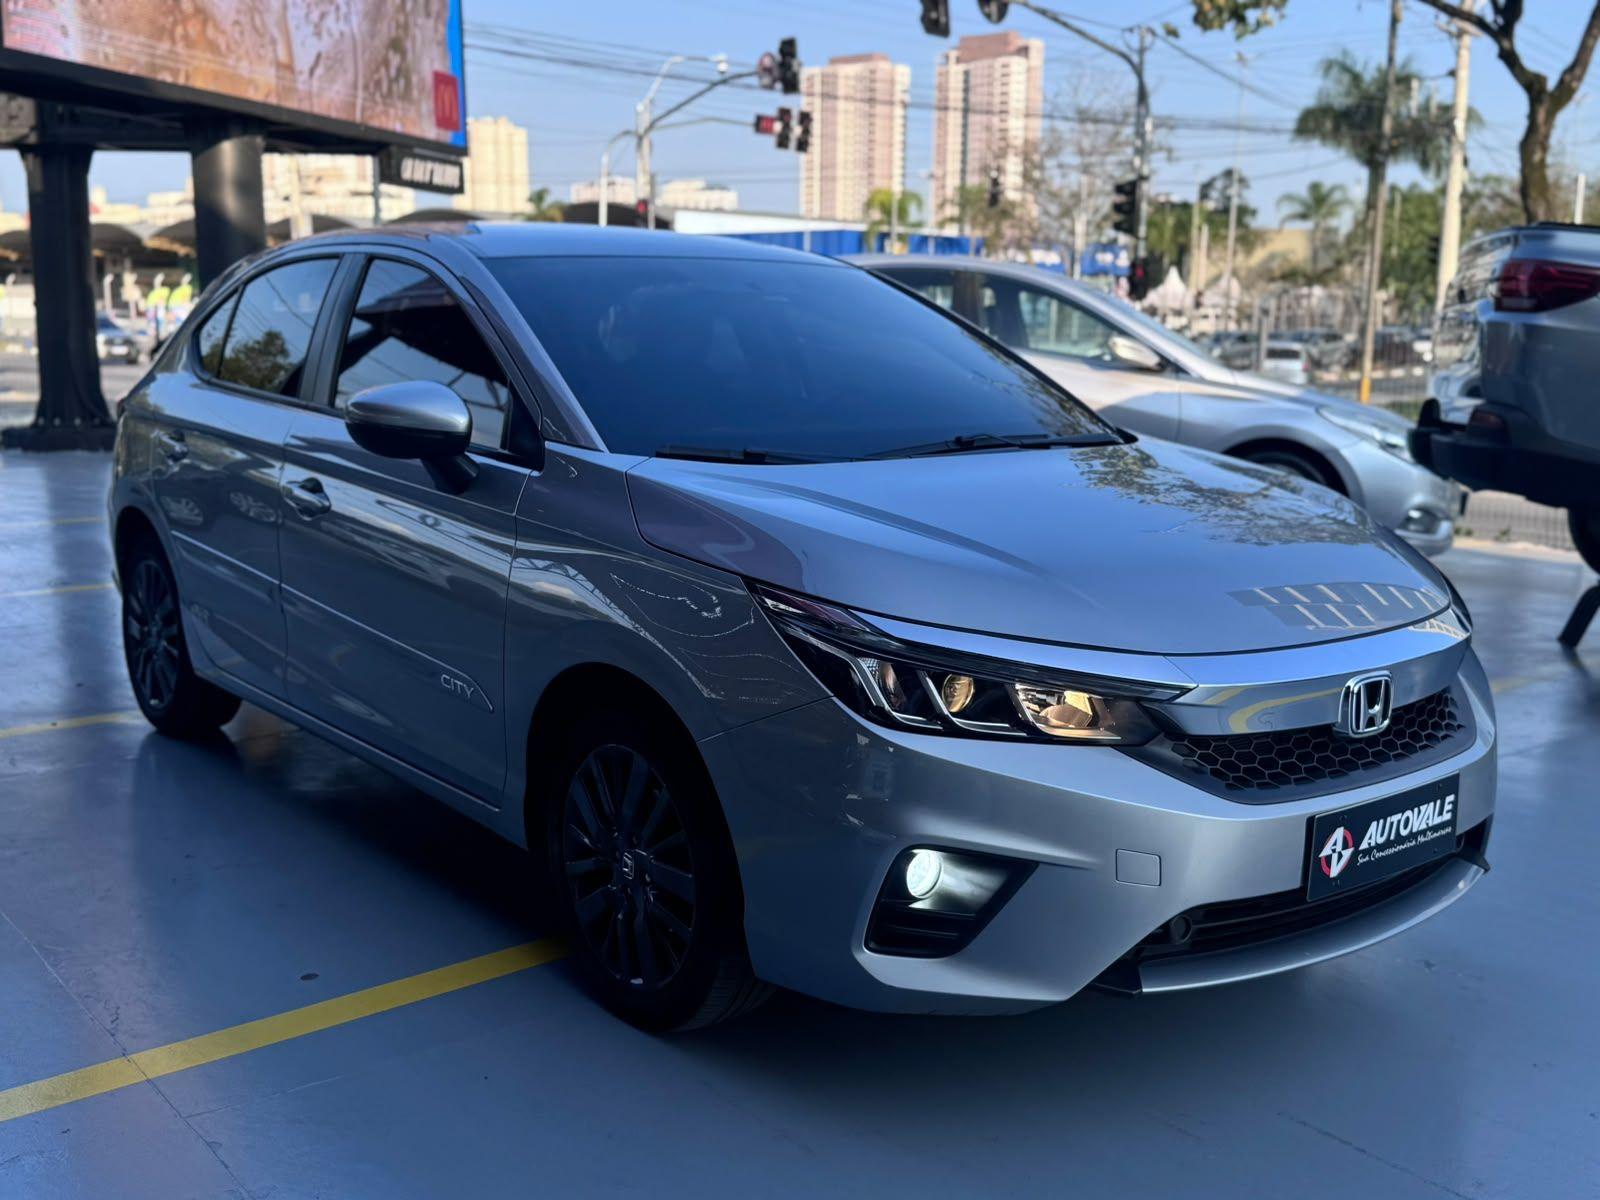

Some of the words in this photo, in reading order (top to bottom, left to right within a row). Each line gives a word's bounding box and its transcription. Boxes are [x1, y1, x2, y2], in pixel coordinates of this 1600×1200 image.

[440, 673, 474, 698] CITY
[1358, 794, 1455, 850] AUTOVALE
[1357, 853, 1370, 866] Sua
